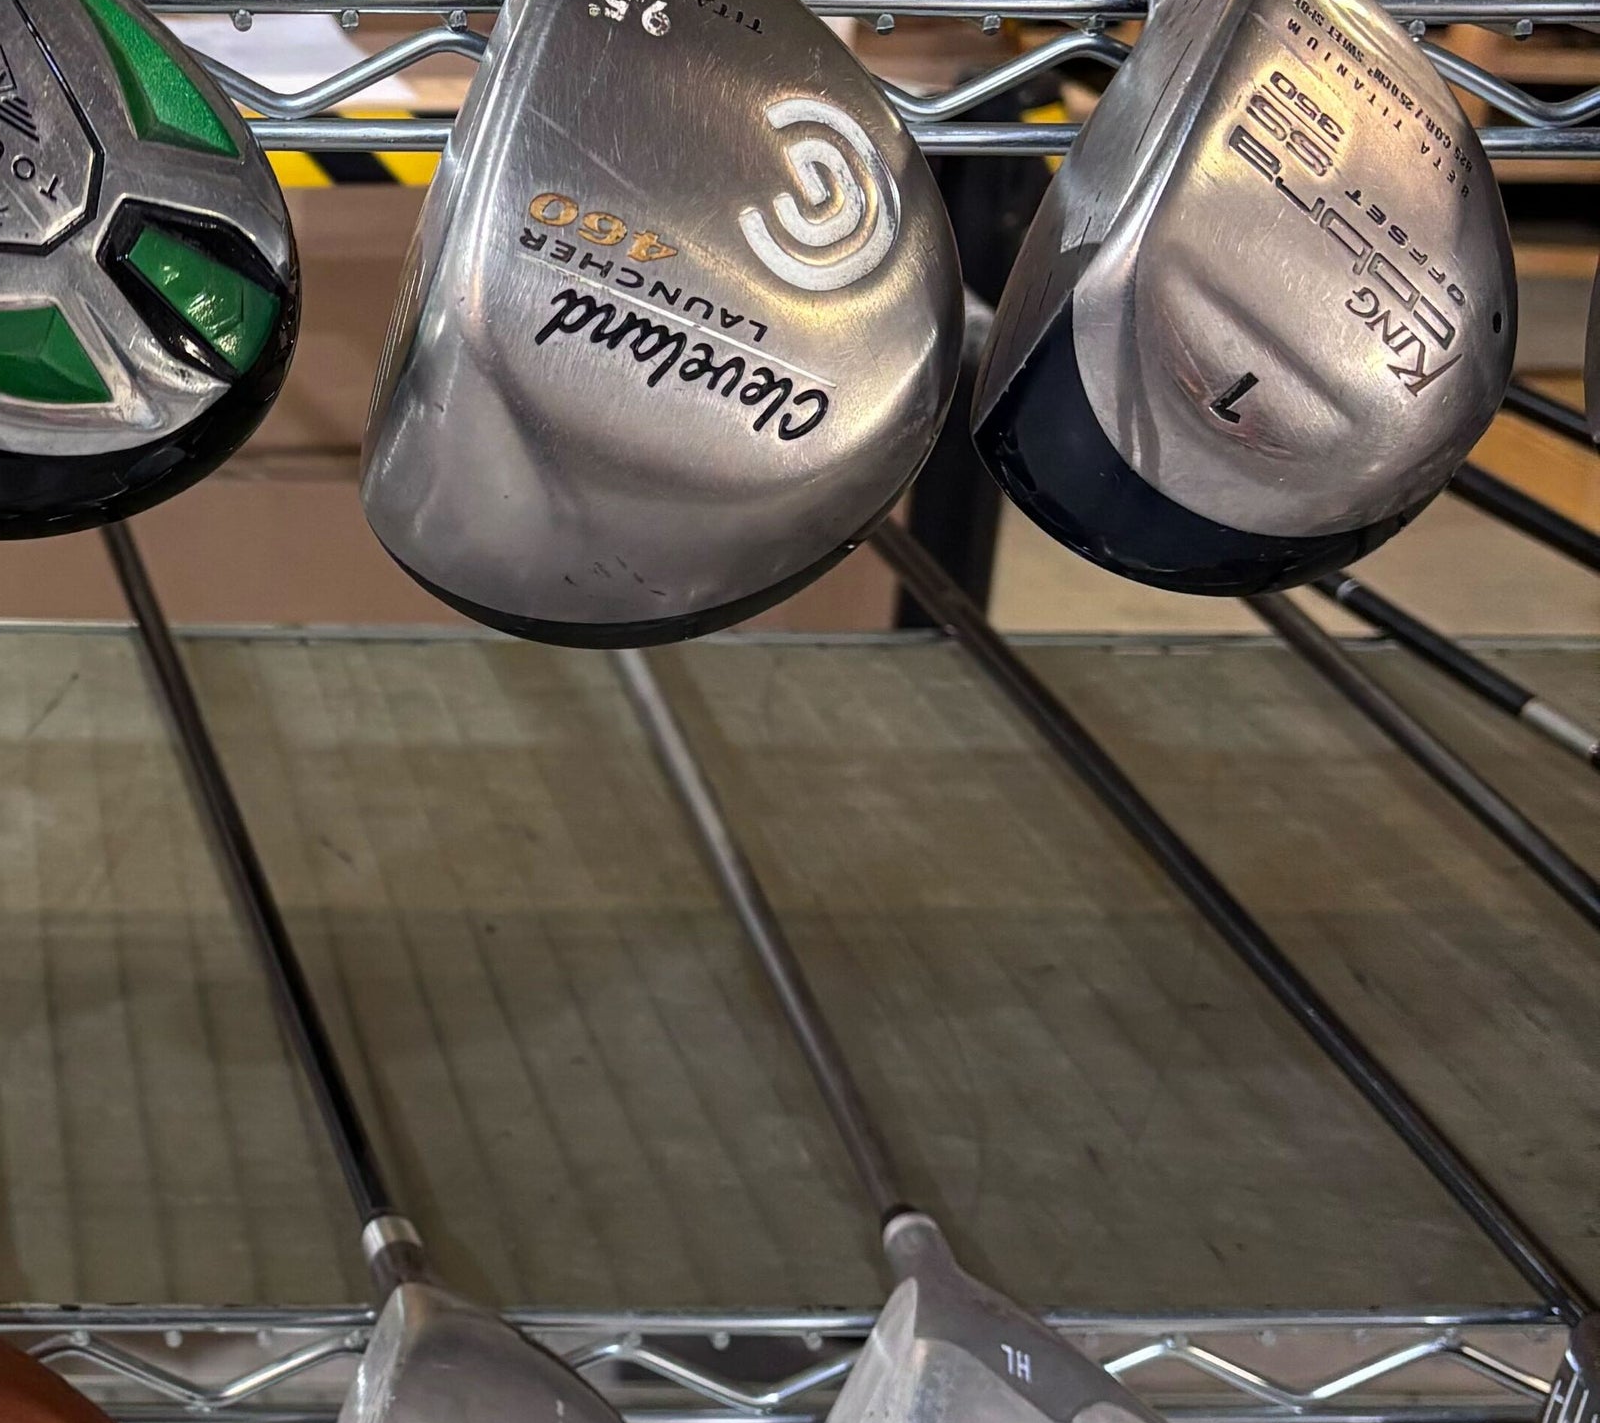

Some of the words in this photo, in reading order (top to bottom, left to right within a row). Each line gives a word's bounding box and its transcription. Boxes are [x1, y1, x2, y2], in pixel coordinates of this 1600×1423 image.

[1270, 70, 1345, 142] 350
[1288, 18, 1404, 131] TITANIUM
[1421, 142, 1470, 198] BETA
[529, 190, 678, 263] 460
[1345, 188, 1464, 307] OFFSET
[520, 226, 768, 342] LAUNCHER
[536, 286, 829, 442] Cleveland
[1209, 372, 1259, 424] 1
